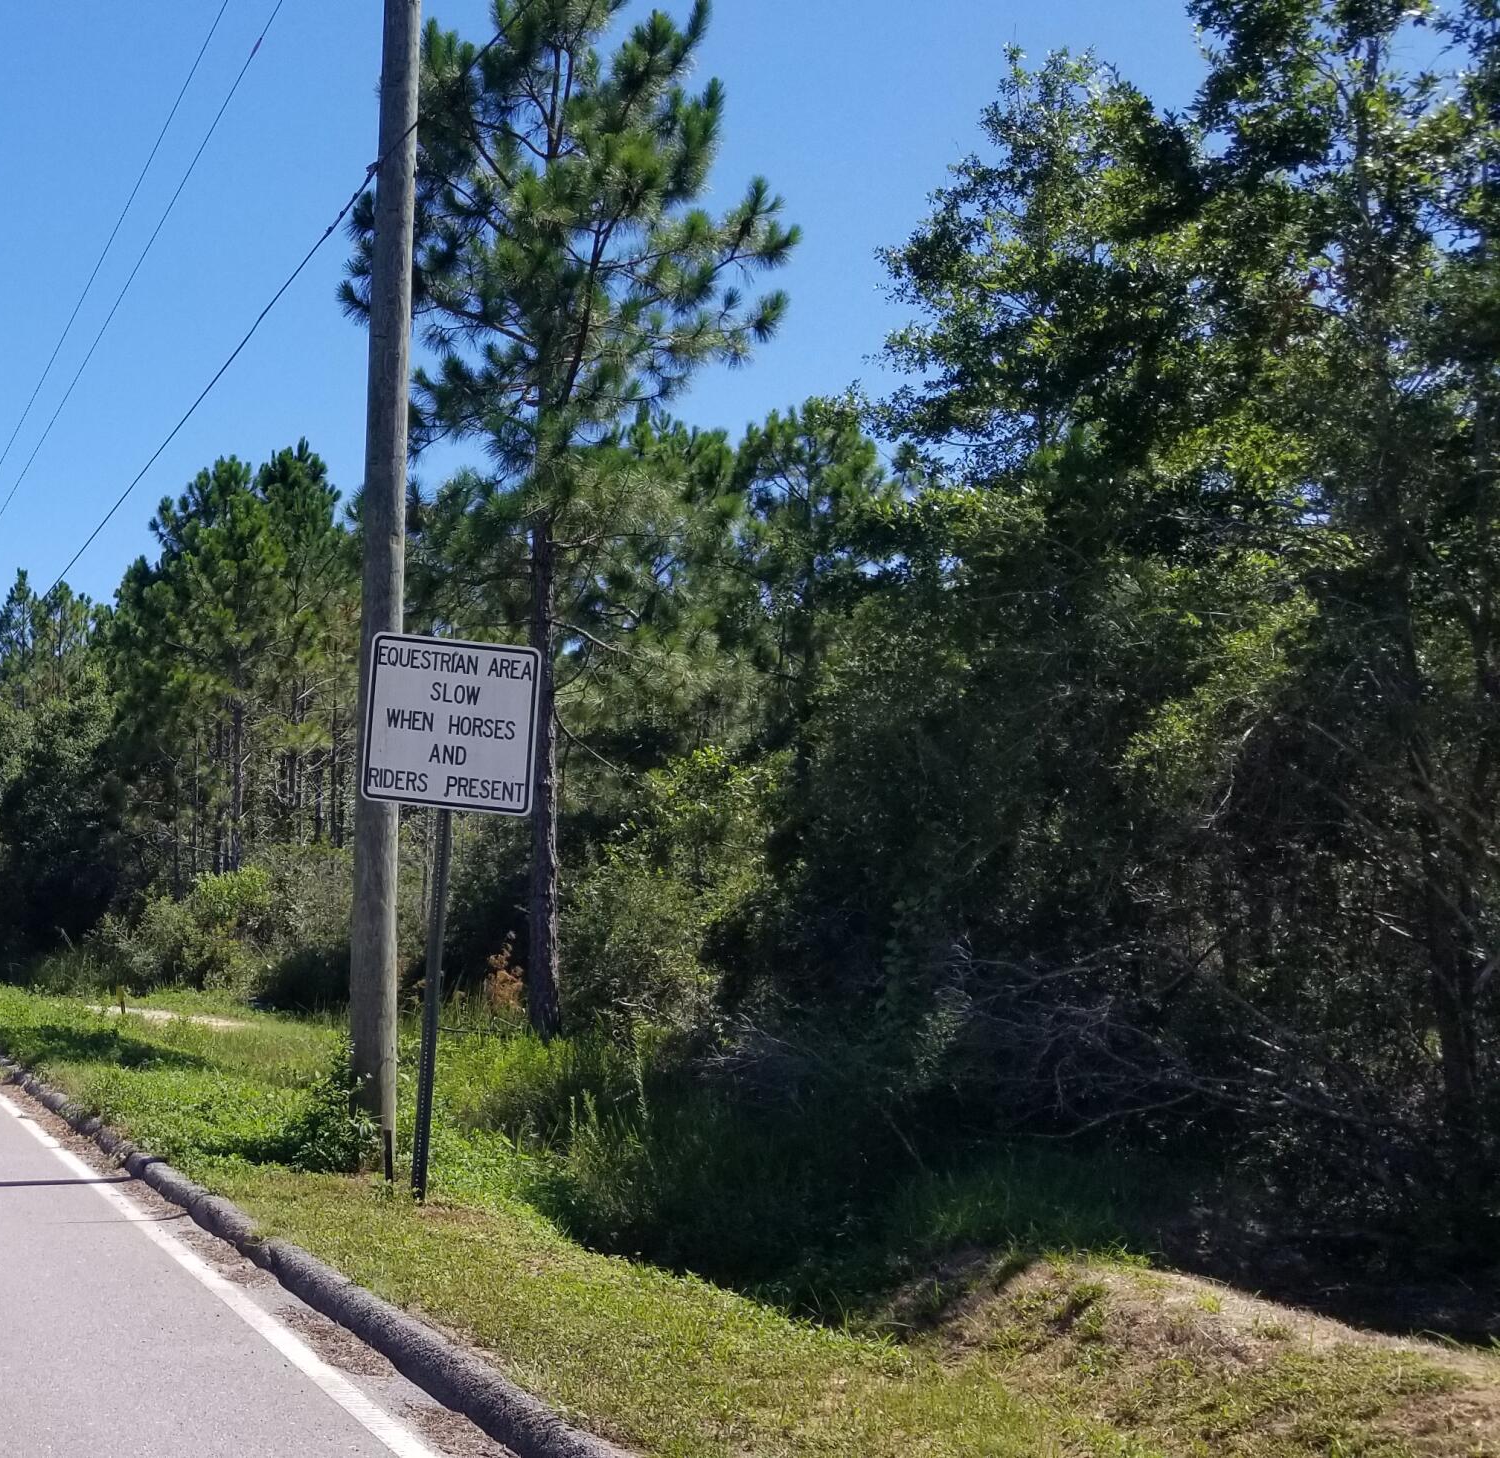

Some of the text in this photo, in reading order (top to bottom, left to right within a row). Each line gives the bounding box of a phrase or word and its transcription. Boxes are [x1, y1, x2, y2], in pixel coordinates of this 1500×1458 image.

[377, 645, 532, 681] EQUESTRIAN AREA
[430, 681, 481, 706] SLOW
[386, 708, 516, 740] WHEN HORSES
[428, 743, 467, 766] AND
[368, 767, 525, 803] RIDERS PRESENT
